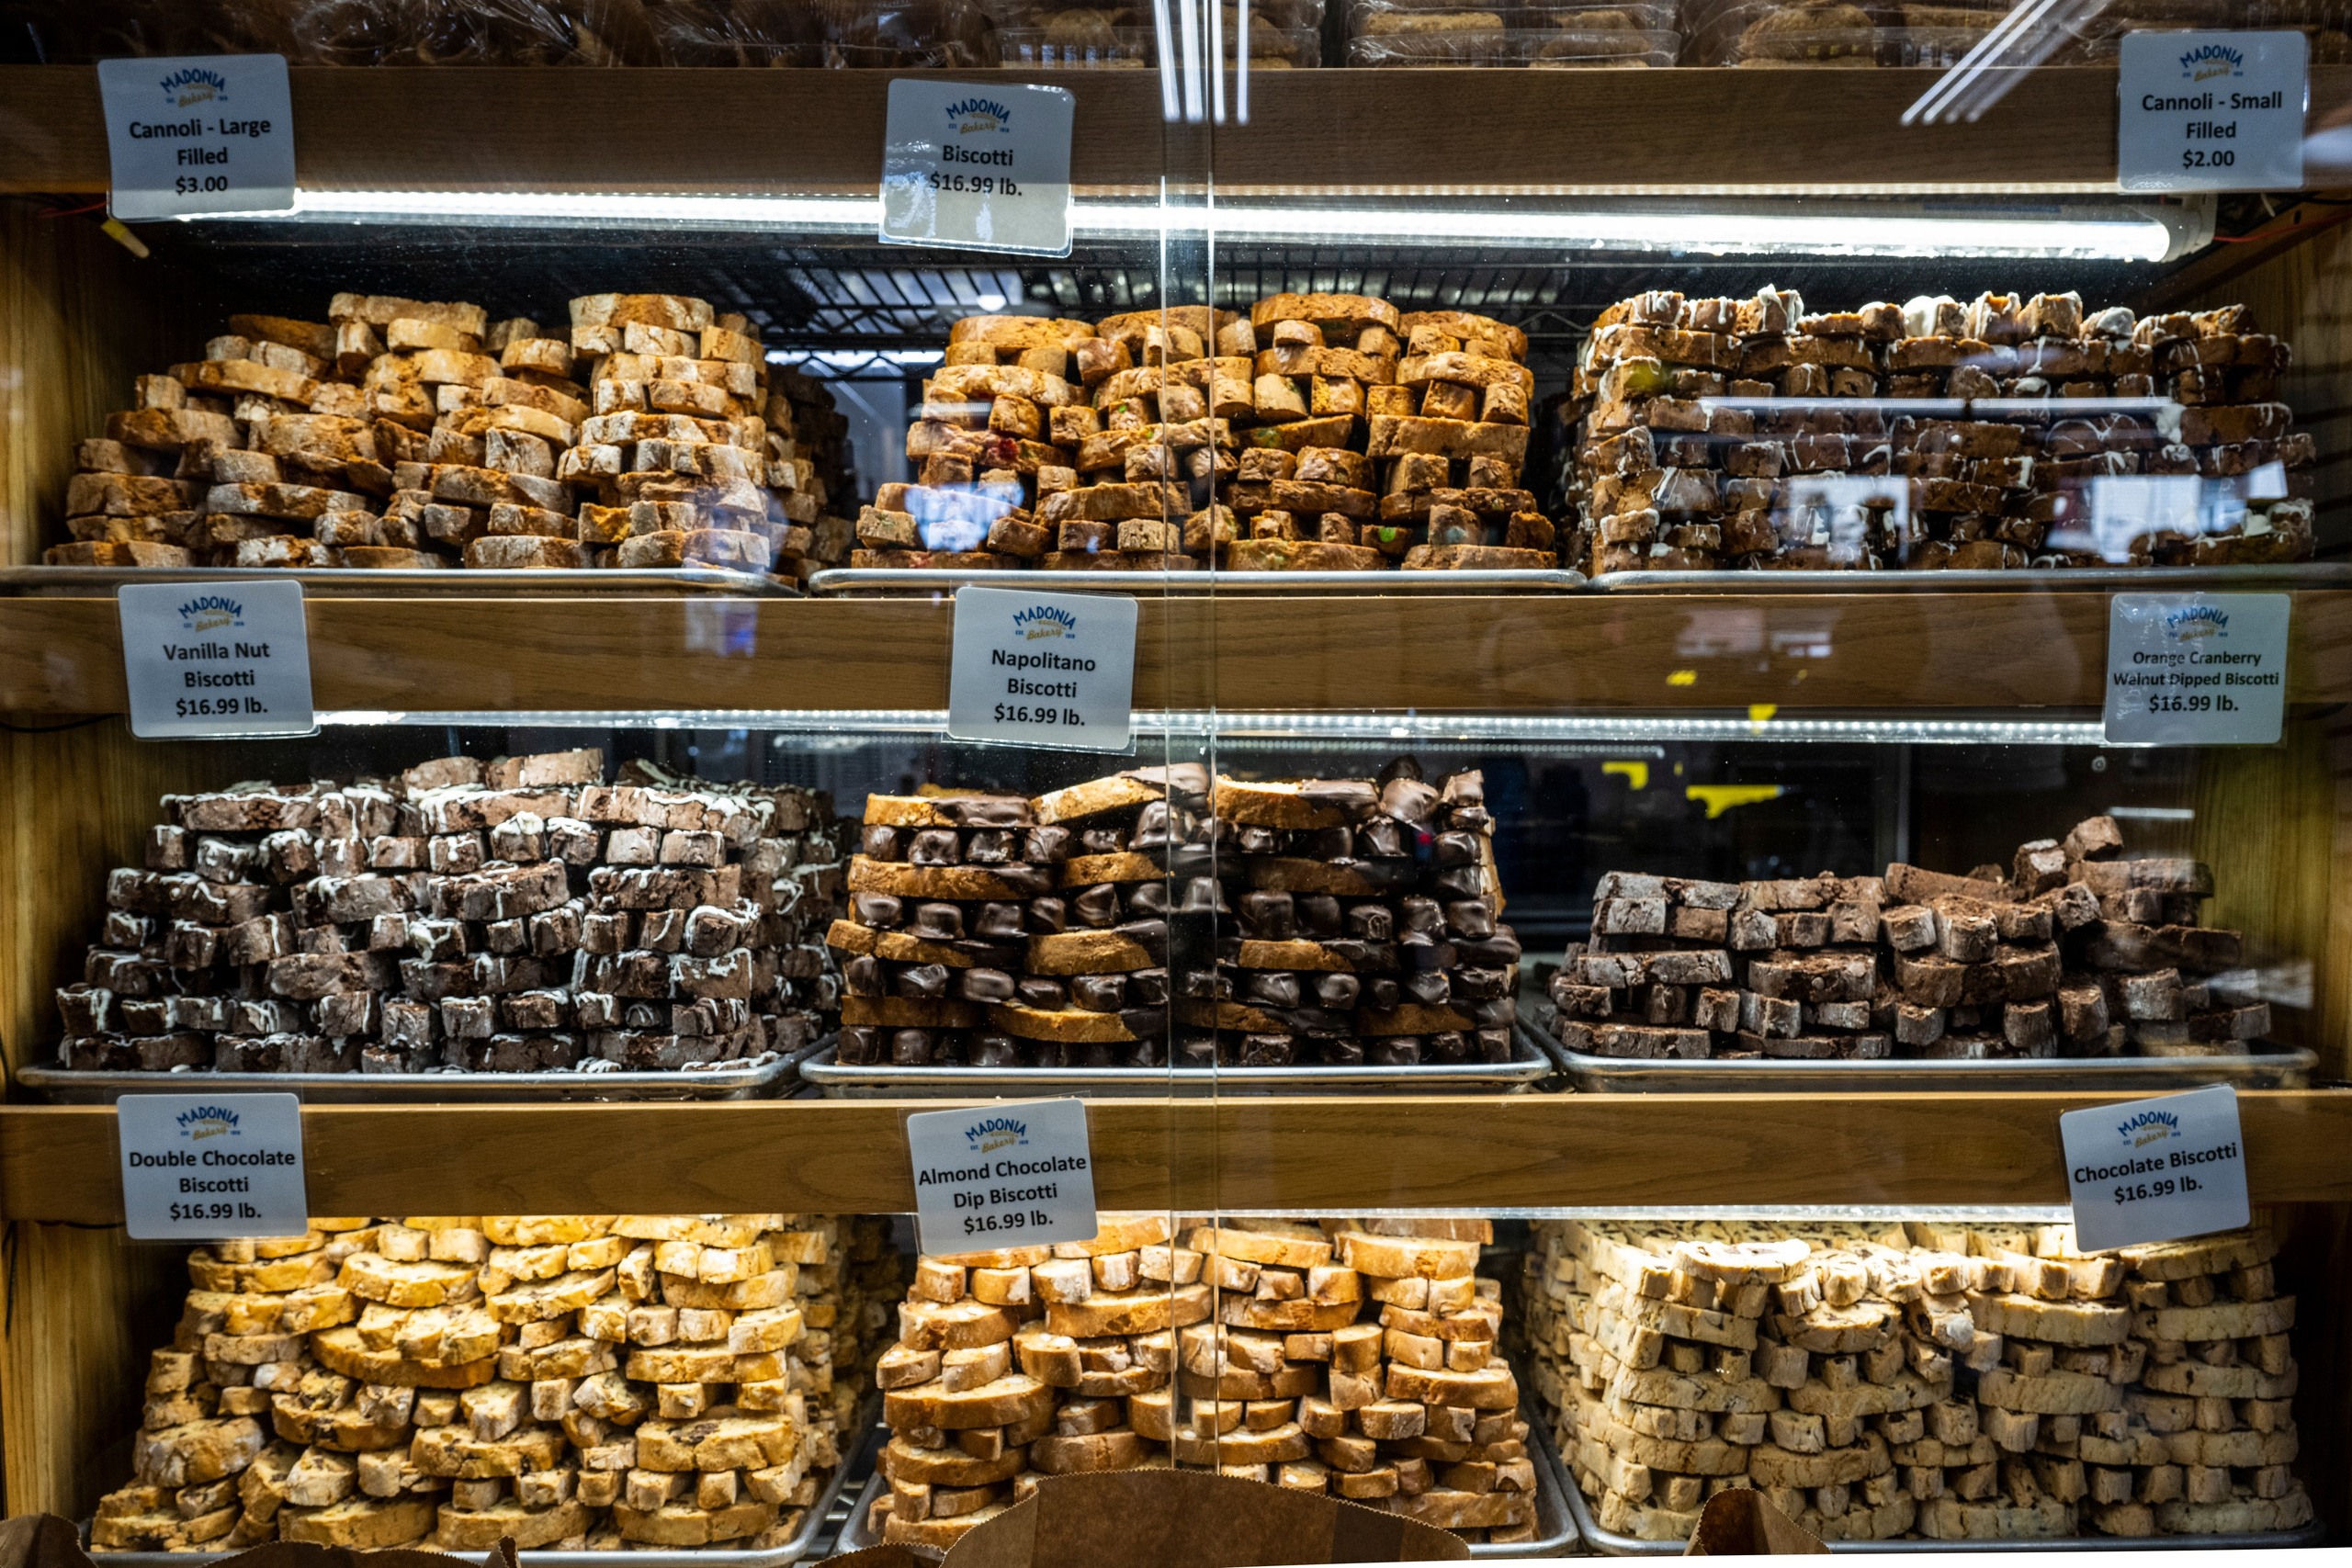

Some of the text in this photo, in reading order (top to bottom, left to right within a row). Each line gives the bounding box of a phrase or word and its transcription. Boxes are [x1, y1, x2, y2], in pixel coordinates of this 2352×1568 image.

[2179, 45, 2244, 69] MADONIA
[160, 69, 225, 93] MADONIA
[946, 98, 1011, 124] MADONIA
[2143, 93, 2212, 111] Cannoli
[2231, 92, 2282, 109] Small
[130, 119, 201, 138] Cannoli
[220, 118, 271, 137] Large
[960, 120, 997, 134] Bakery
[2187, 121, 2236, 139] Filled
[177, 147, 228, 165] Filled
[943, 145, 1013, 166] Biscotti
[2183, 149, 2234, 170] $2.00
[175, 176, 228, 196] $3.00
[930, 171, 1023, 197] $16.99 lb.
[178, 596, 243, 619] MADONIA
[1012, 605, 1077, 630] MADONIA
[2166, 606, 2230, 628] MADONIA
[1026, 627, 1063, 640] Bakery
[163, 643, 271, 660] Vanilla Nut
[991, 649, 1096, 671] Napolitano
[2132, 651, 2262, 667] Orange Cranberry
[185, 670, 255, 688] Biscotti
[1007, 678, 1077, 698] Biscotti
[2113, 672, 2279, 688] Walnut Dipped Biscotti
[175, 697, 268, 717] $16.99 lb.
[2149, 694, 2239, 714] $16.99 lb.
[994, 703, 1086, 727] $16.99 lb.
[175, 1106, 240, 1128] MADONIA
[2117, 1111, 2178, 1137] MADONIA
[965, 1118, 1027, 1142] MADONIA
[2134, 1130, 2168, 1148] Bakery
[981, 1137, 1016, 1154] Bakery
[130, 1149, 296, 1168] Double Chocolate
[2074, 1142, 2237, 1183] Chocolate Biscotti
[919, 1156, 1087, 1186] Almond Chocolate
[179, 1177, 249, 1193] Biscotti
[954, 1182, 1057, 1209] Dip Biscotti
[2114, 1176, 2203, 1205] $16.99 lb.
[170, 1201, 262, 1222] $16.99 lb.
[964, 1210, 1054, 1235] $16.99 lb.
